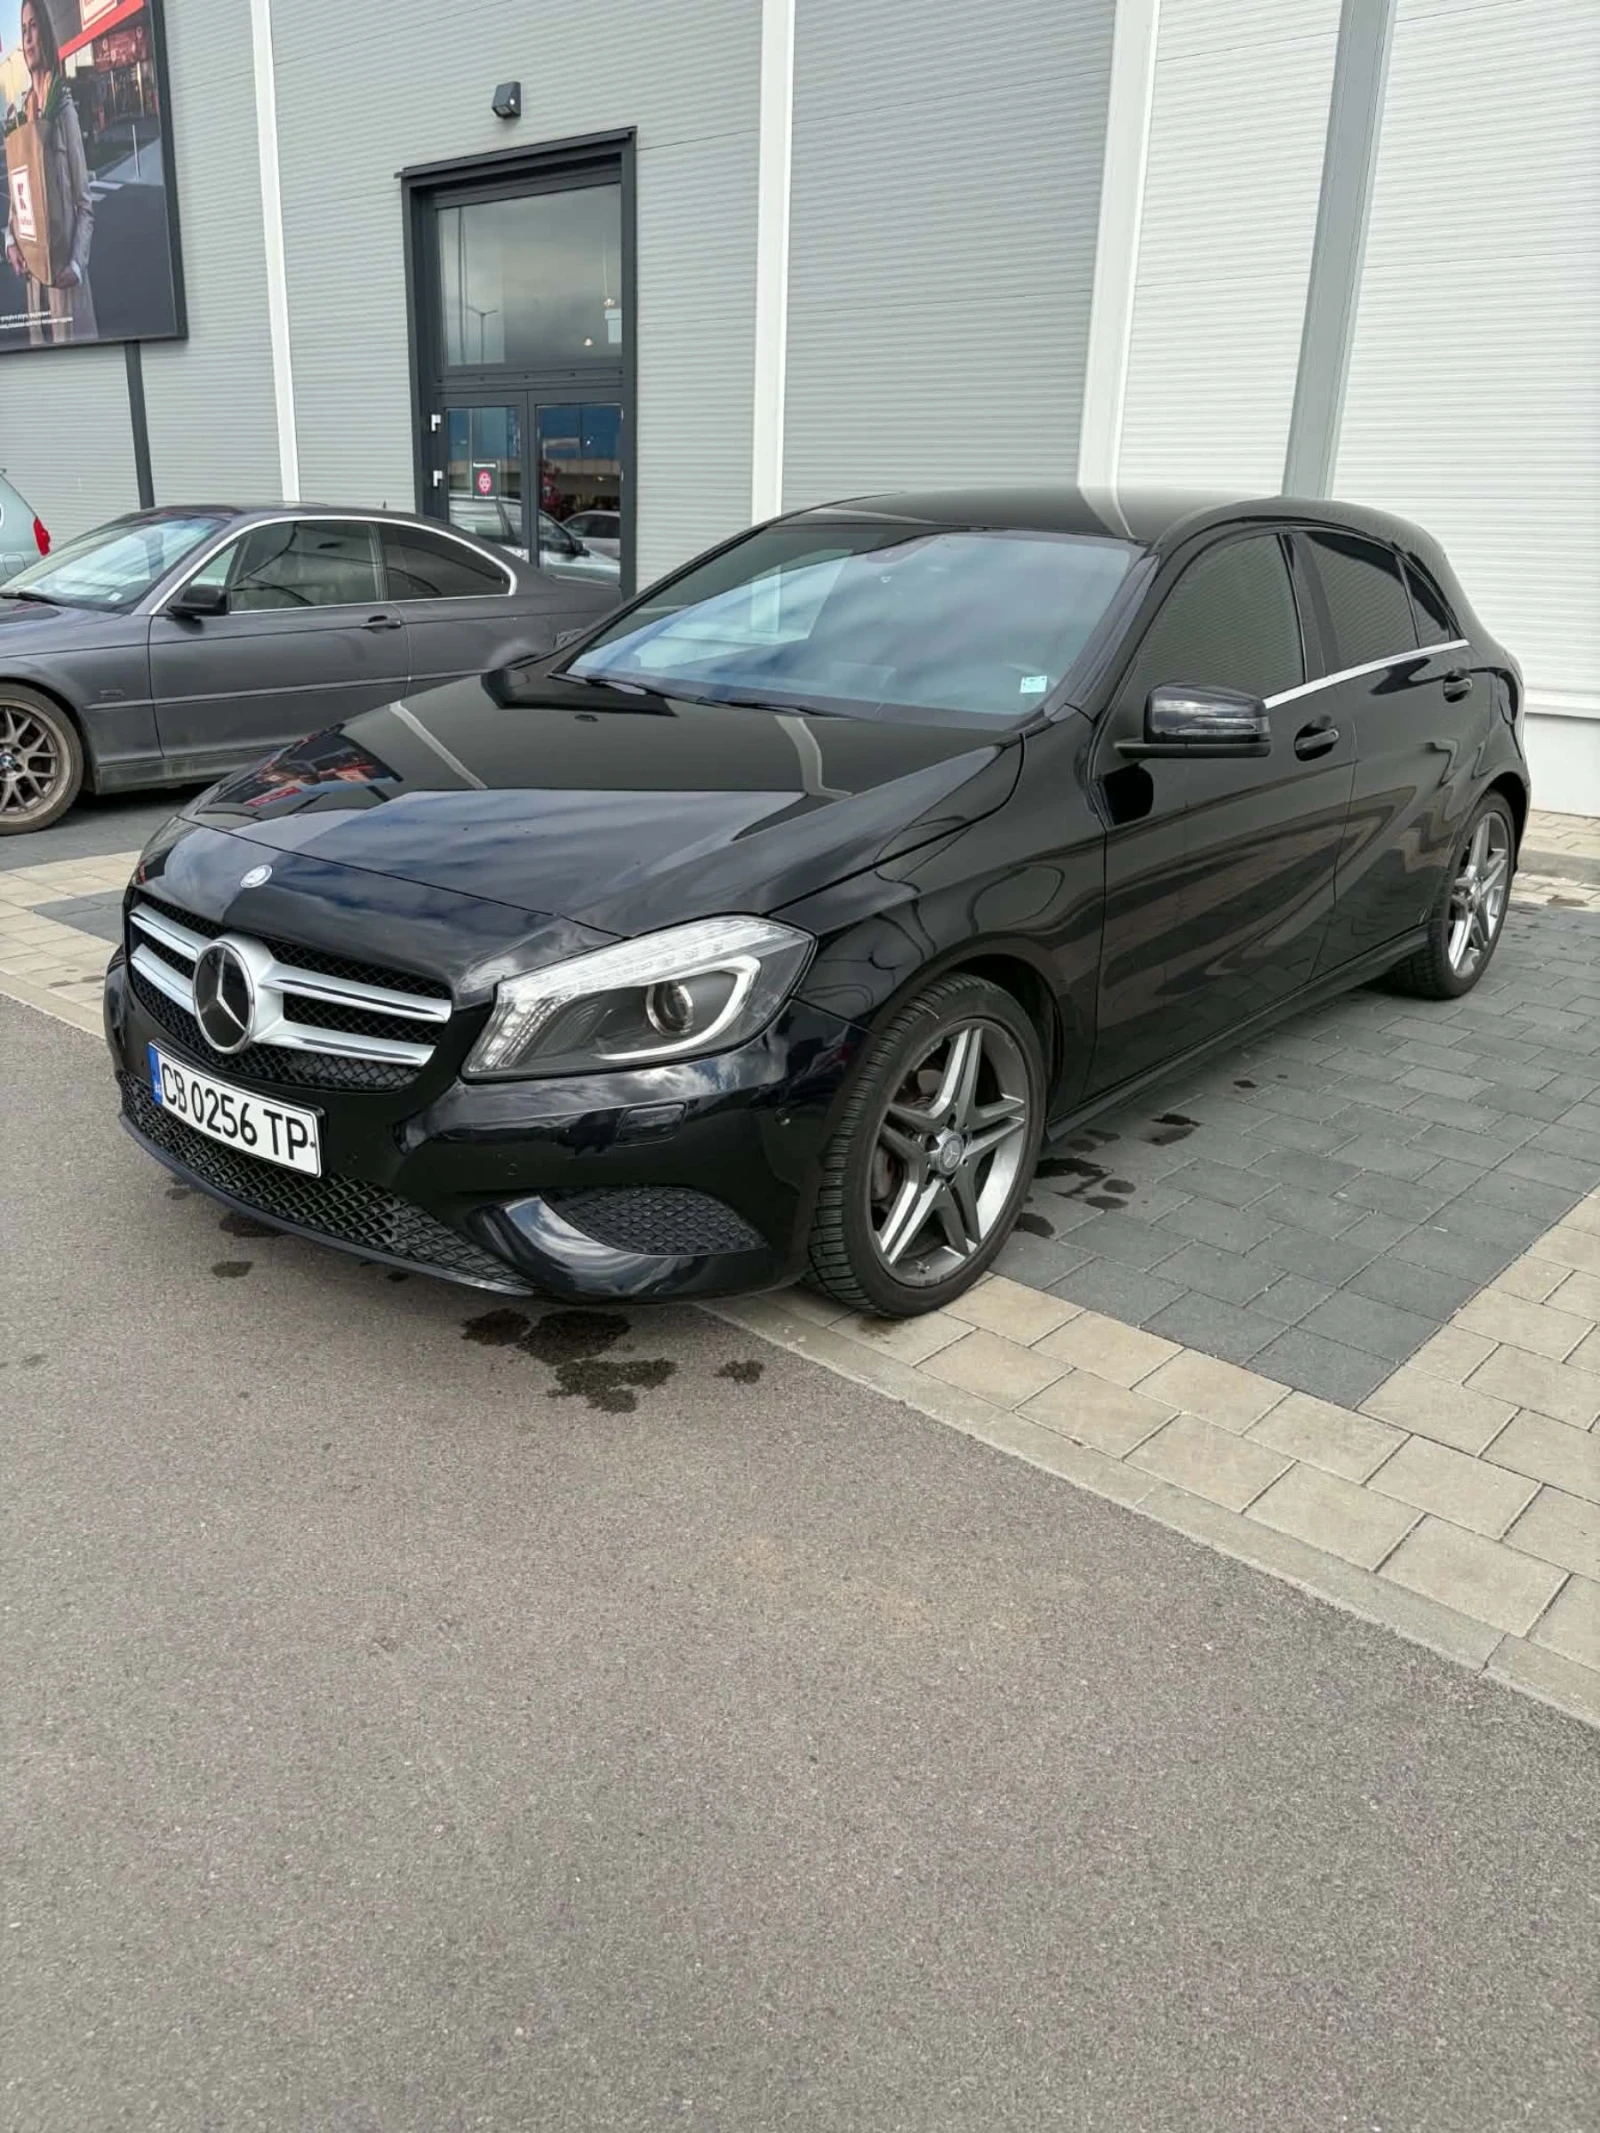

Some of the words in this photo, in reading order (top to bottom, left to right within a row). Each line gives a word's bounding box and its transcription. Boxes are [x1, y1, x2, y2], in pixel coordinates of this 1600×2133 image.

[161, 1063, 187, 1114] CB
[191, 1081, 257, 1147] 0256
[263, 1109, 308, 1160] TP
